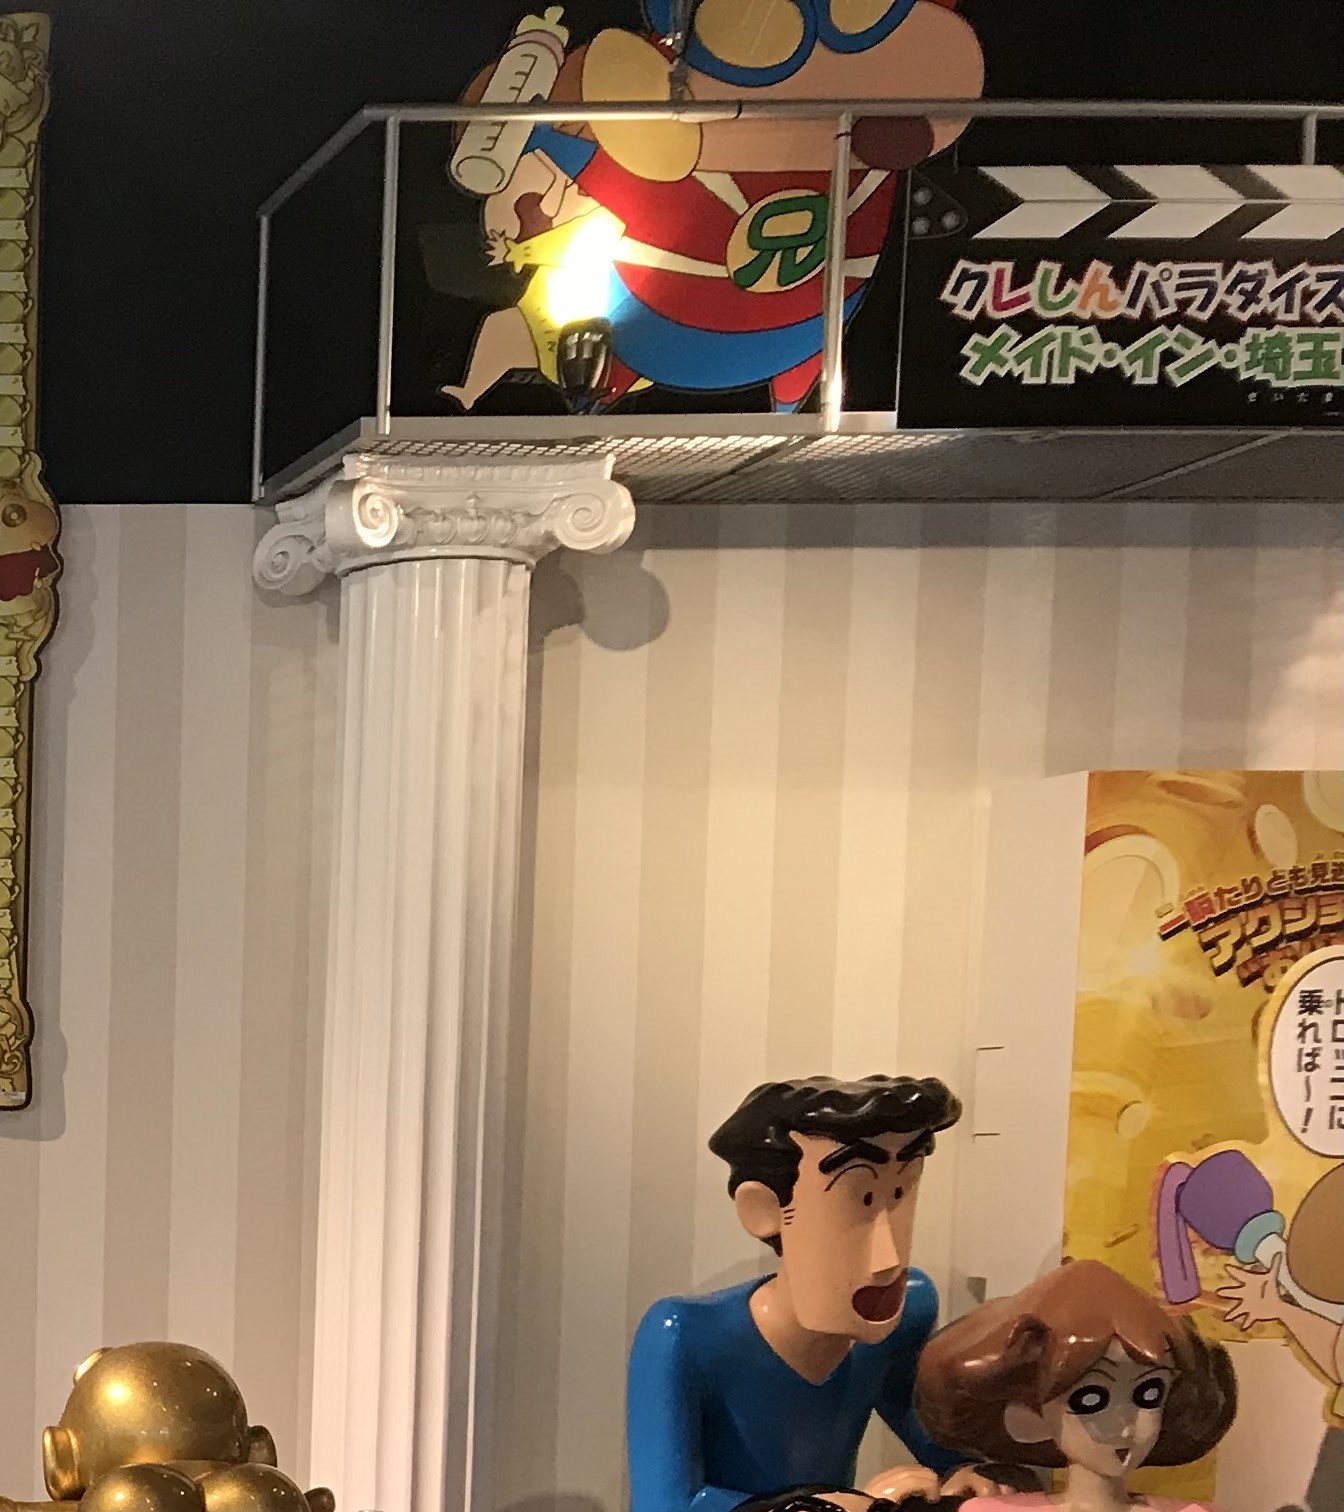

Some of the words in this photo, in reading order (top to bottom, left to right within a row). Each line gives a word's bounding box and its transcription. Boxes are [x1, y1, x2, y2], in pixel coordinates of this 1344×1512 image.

[948, 258, 1344, 318] クレしんパラダイス
[968, 330, 1341, 382] メイド・イン・埼玉
